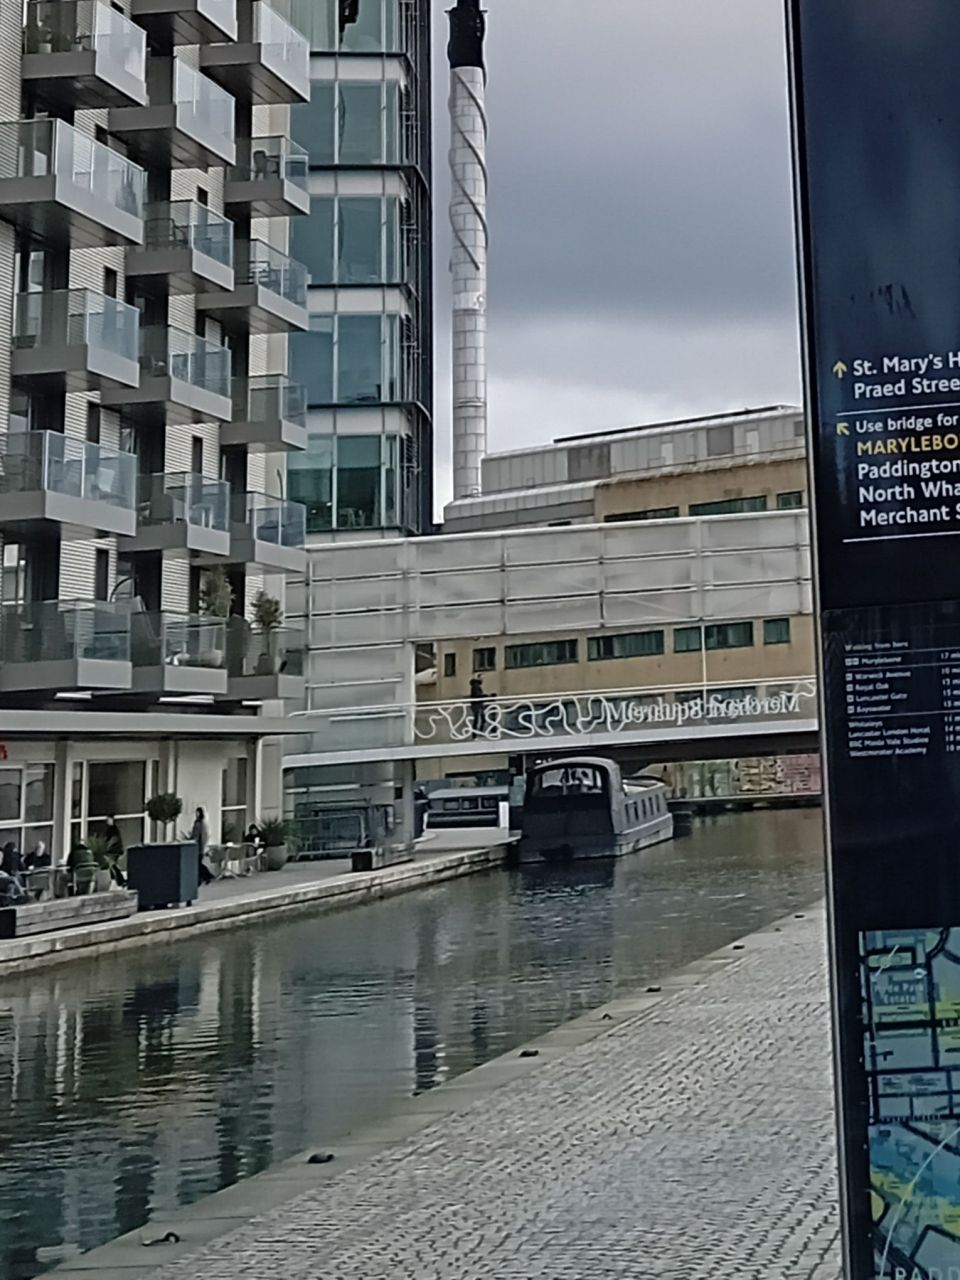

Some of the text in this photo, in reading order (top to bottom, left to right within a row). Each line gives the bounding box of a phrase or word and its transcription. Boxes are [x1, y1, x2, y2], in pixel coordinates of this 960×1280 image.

[853, 359, 877, 376] St.
[883, 354, 943, 374] Mary's
[854, 379, 906, 399] Praed
[855, 413, 959, 433] Use bridge for
[858, 484, 915, 503] North
[860, 506, 950, 526] Merchant
